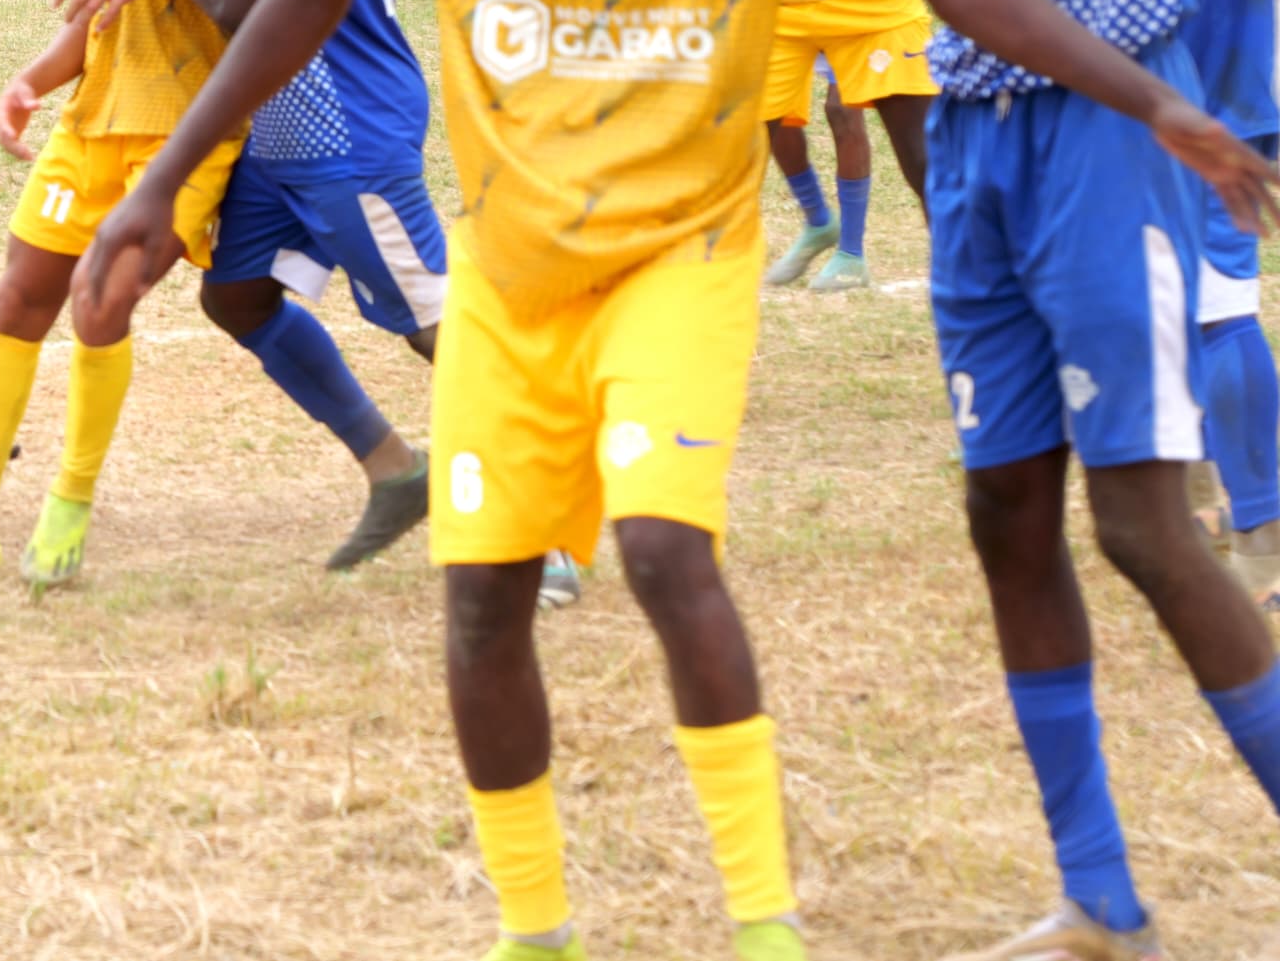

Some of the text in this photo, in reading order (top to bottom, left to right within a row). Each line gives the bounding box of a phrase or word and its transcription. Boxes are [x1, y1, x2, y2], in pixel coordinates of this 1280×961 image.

[552, 23, 715, 60] GABAO
[41, 183, 75, 224] 11
[950, 371, 980, 430] 2
[450, 451, 483, 513] 6
